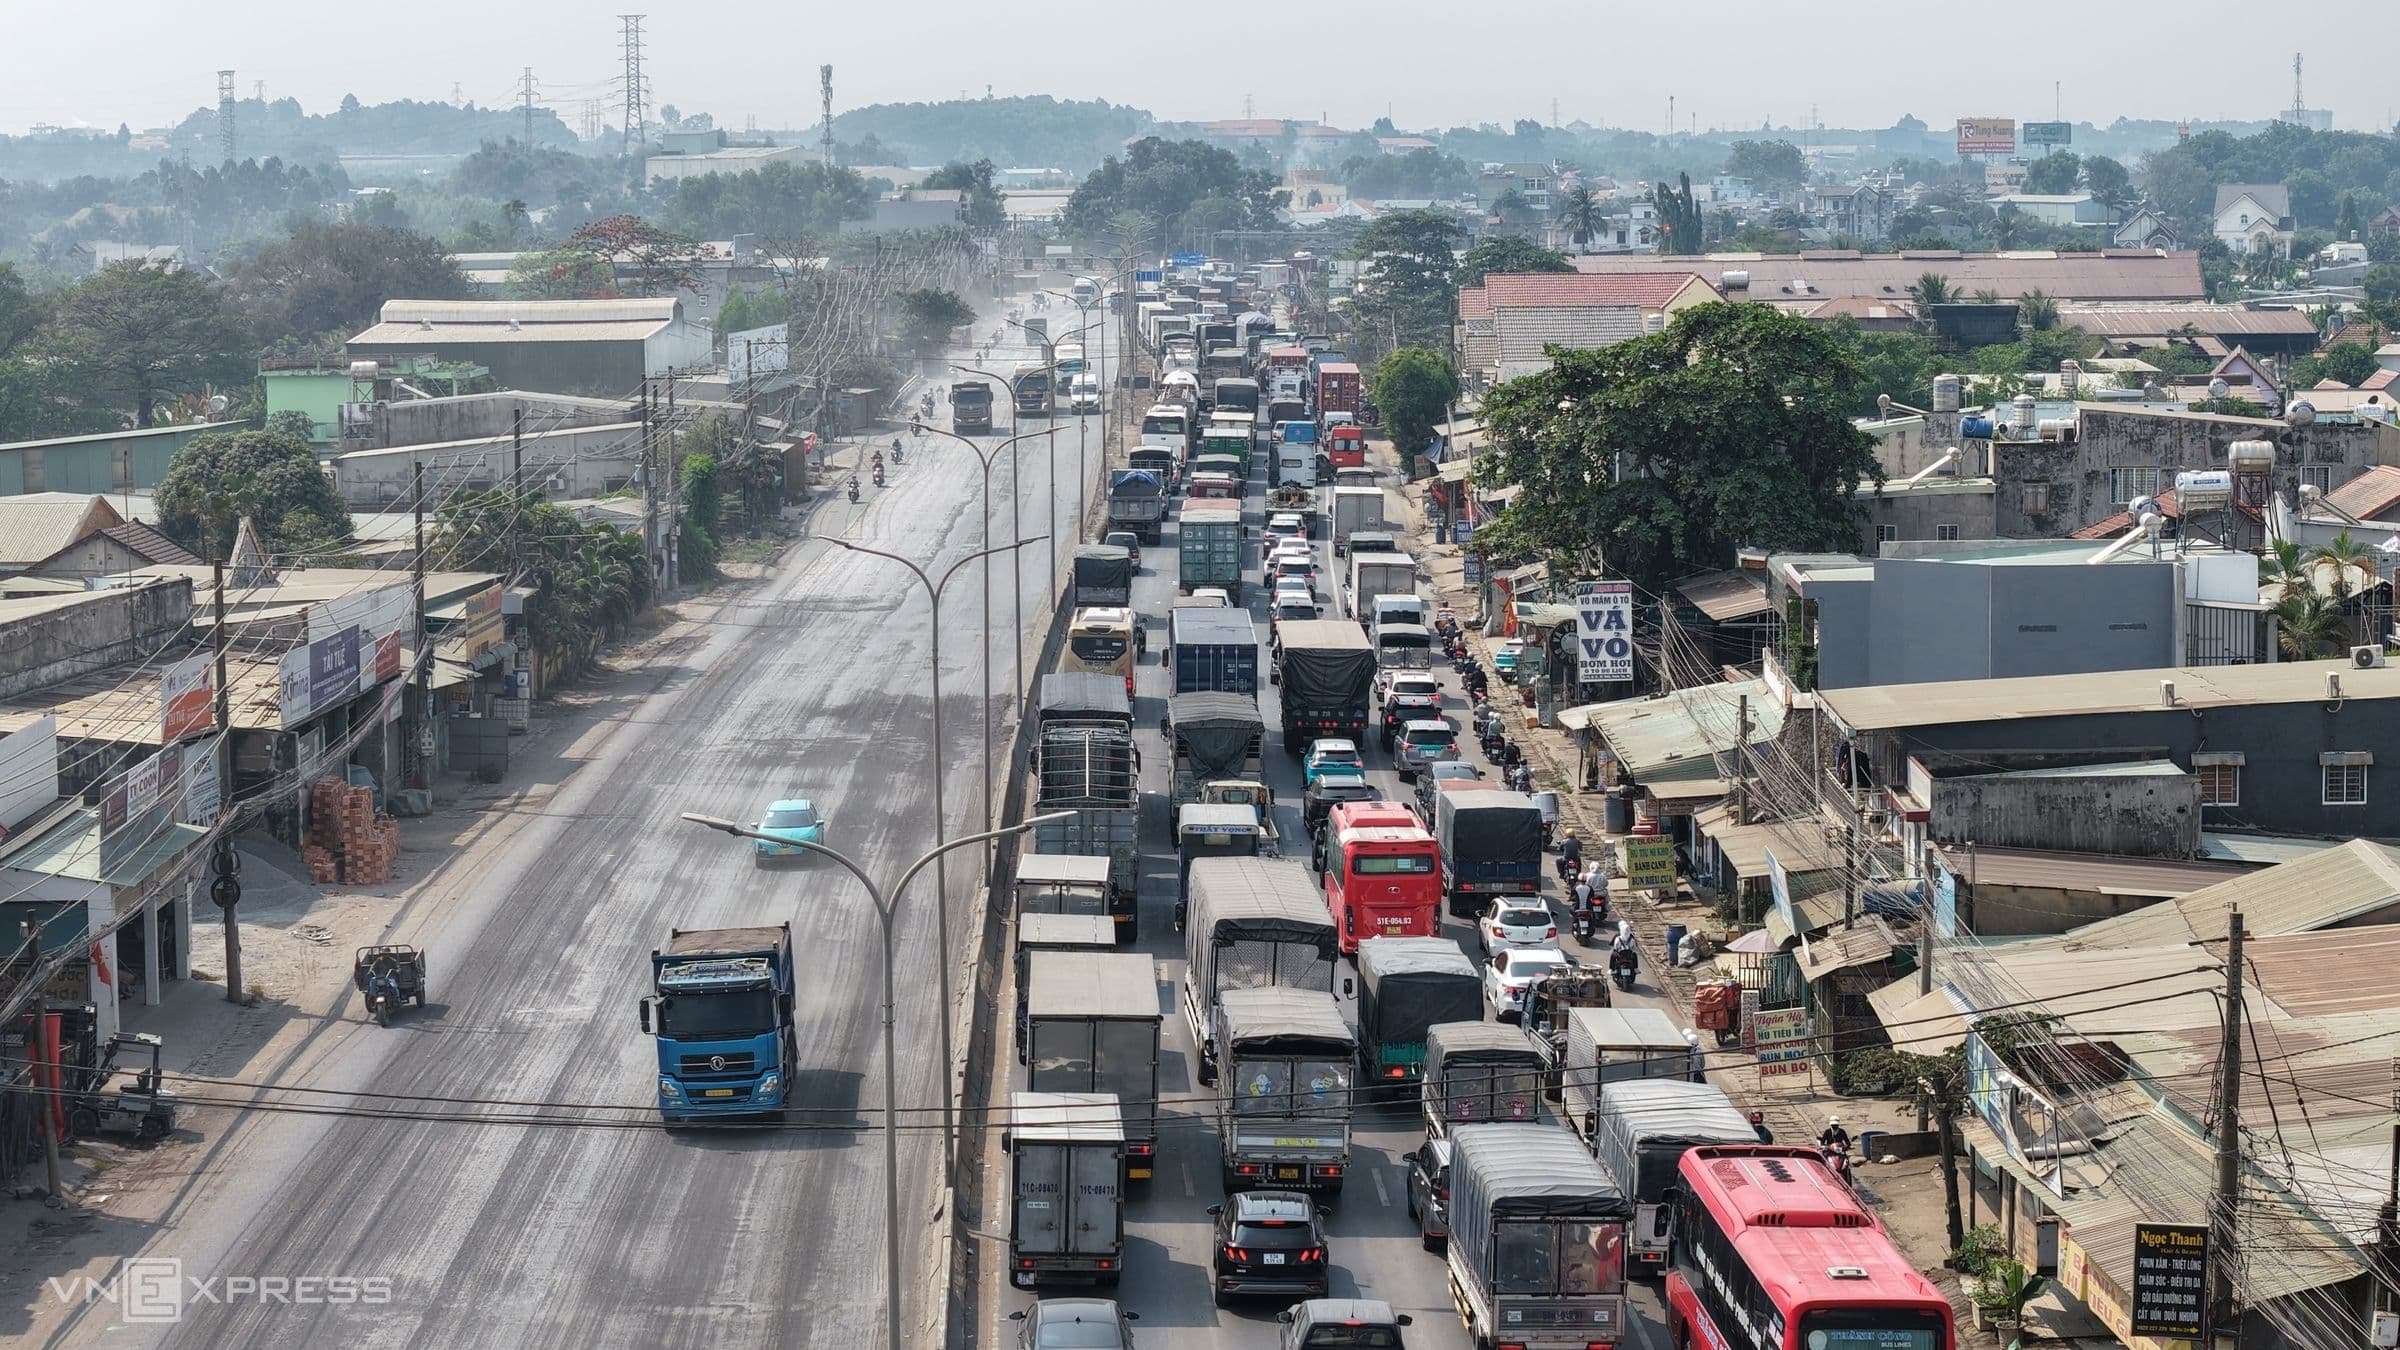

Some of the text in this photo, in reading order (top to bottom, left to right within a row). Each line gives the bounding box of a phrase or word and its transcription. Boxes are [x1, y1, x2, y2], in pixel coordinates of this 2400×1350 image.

[1580, 605, 1628, 632] VÁ
[1581, 631, 1630, 659] VỎ
[2141, 1231, 2204, 1248] Ngọc Thanh
